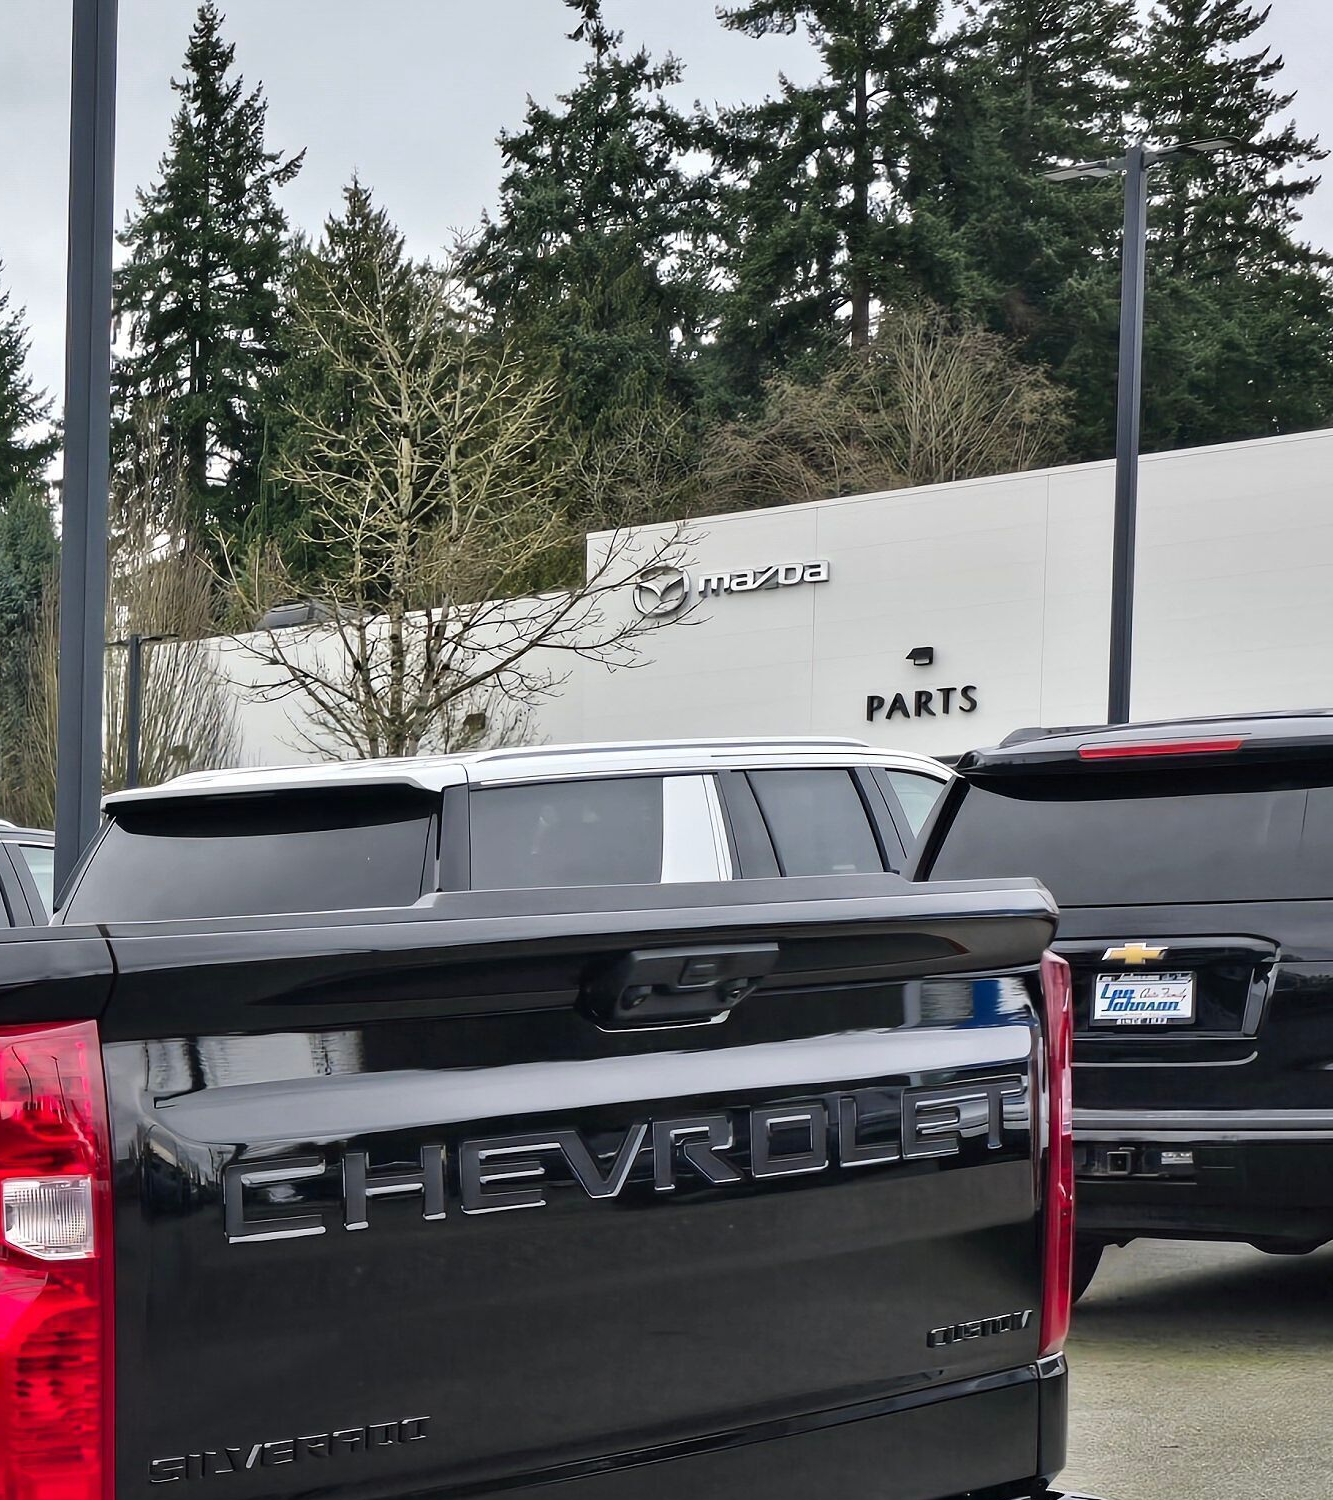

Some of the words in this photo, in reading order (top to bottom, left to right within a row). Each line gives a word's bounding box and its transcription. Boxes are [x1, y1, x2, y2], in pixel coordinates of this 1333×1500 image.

[698, 560, 830, 597] mazda
[866, 685, 978, 722] PARTS
[1100, 983, 1135, 999] Lee
[1101, 1000, 1180, 1012] Johnson
[224, 1075, 1028, 1243] CHEVROLET
[926, 1309, 1033, 1348] CUSTOM
[149, 1416, 431, 1483] SILVERADO
